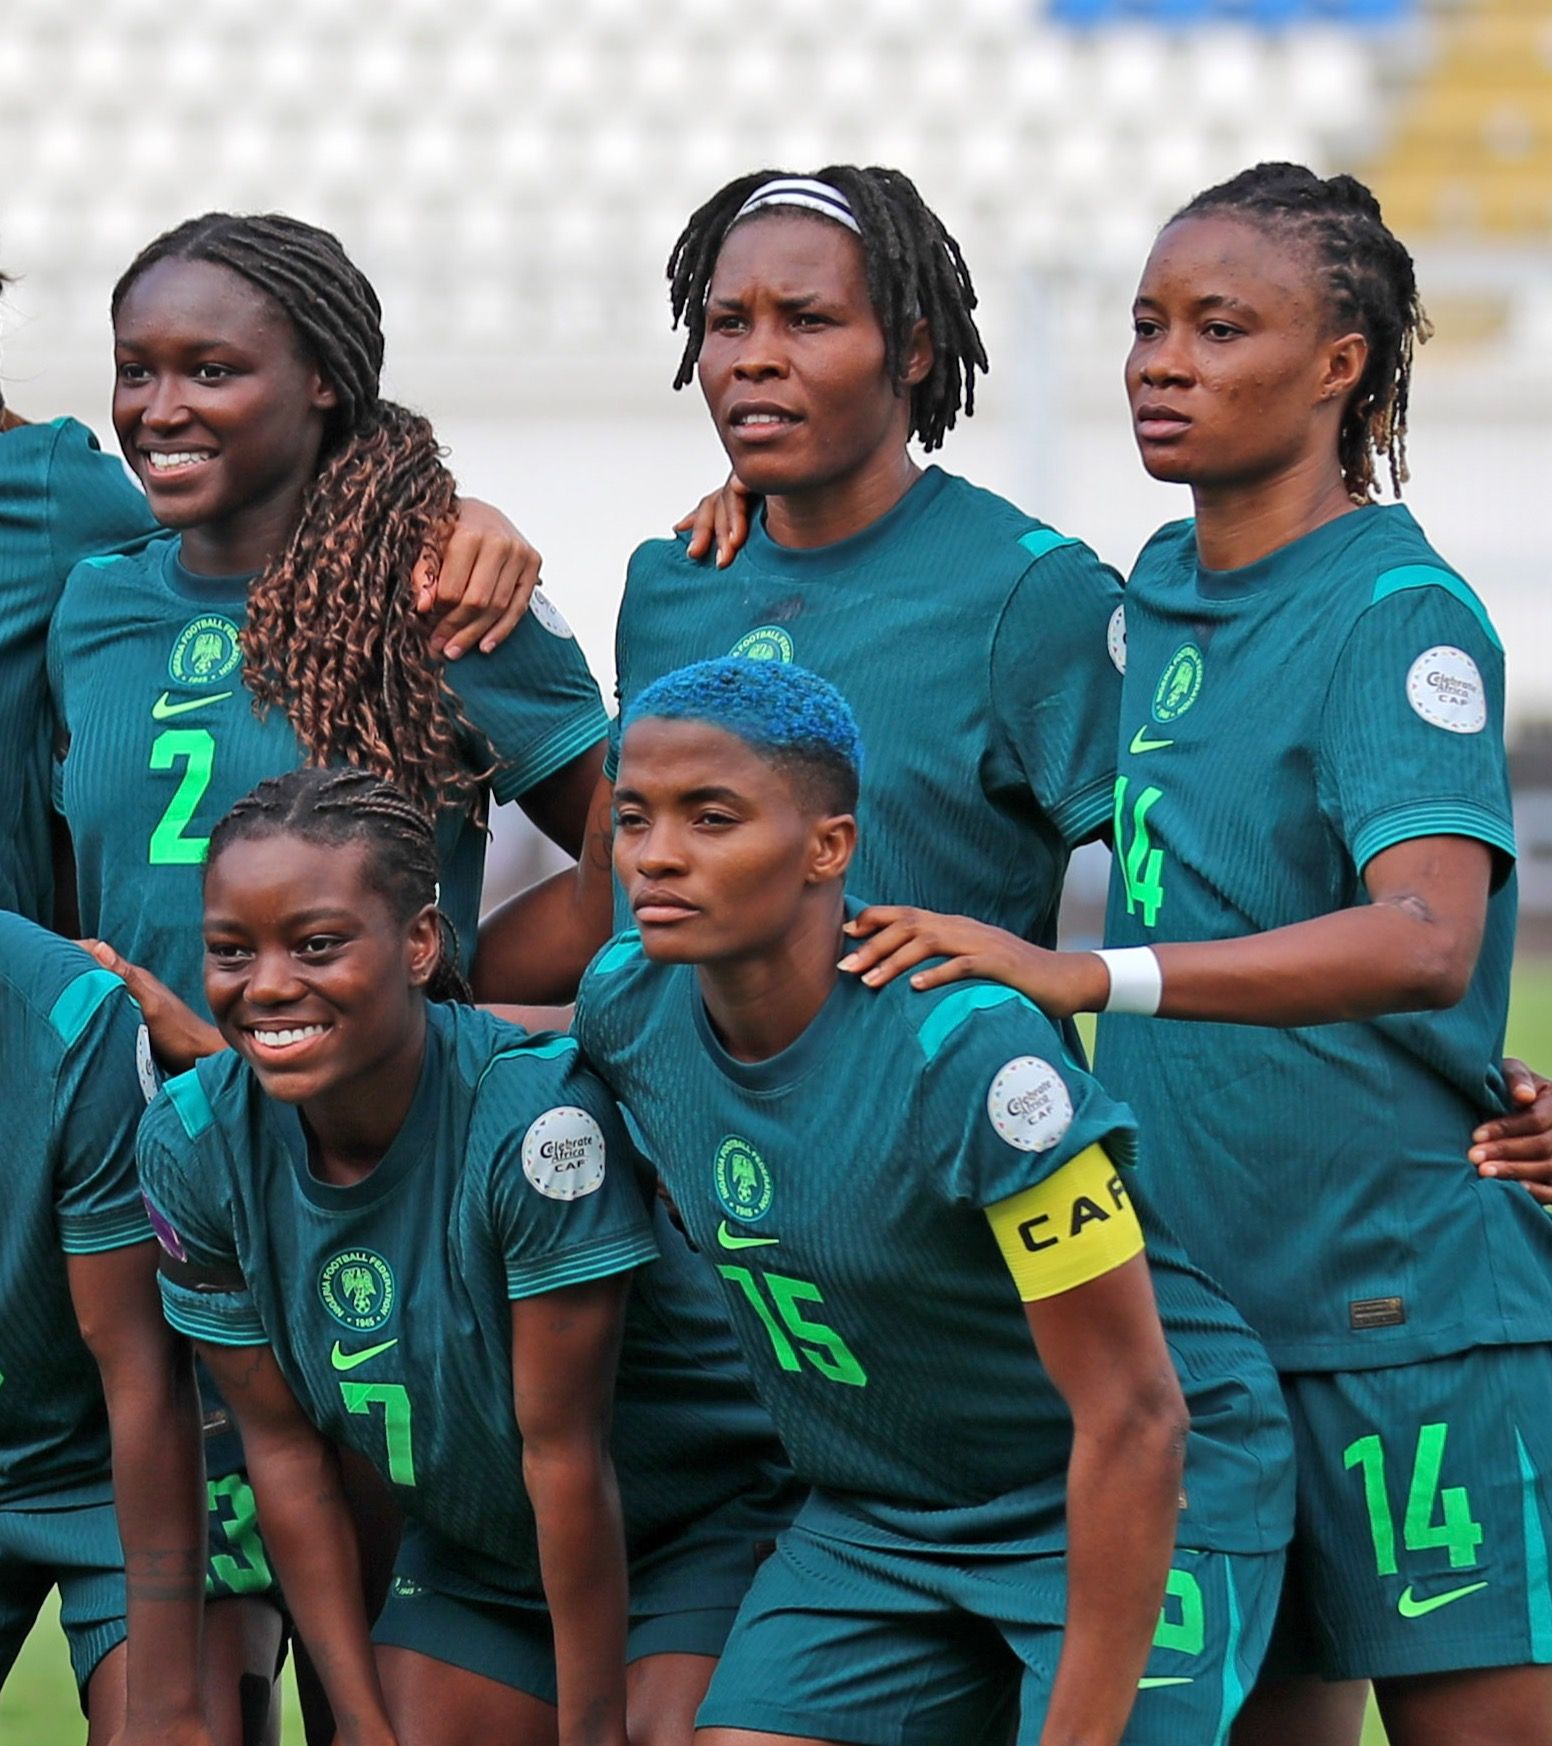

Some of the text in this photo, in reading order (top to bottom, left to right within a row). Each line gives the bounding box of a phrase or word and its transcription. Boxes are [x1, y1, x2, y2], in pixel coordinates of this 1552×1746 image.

[181, 618, 223, 645] FOOTBALL
[148, 730, 217, 865] 2
[1113, 775, 1165, 927] 14
[540, 1136, 592, 1159] Celebrate
[551, 1147, 585, 1164] Africa
[554, 1160, 586, 1173] CAF
[321, 1252, 392, 1318] NIGERIA FOOTBALL FEDERATION
[717, 1264, 868, 1387] 15
[339, 1381, 416, 1486] 7
[1343, 1423, 1484, 1576] 14
